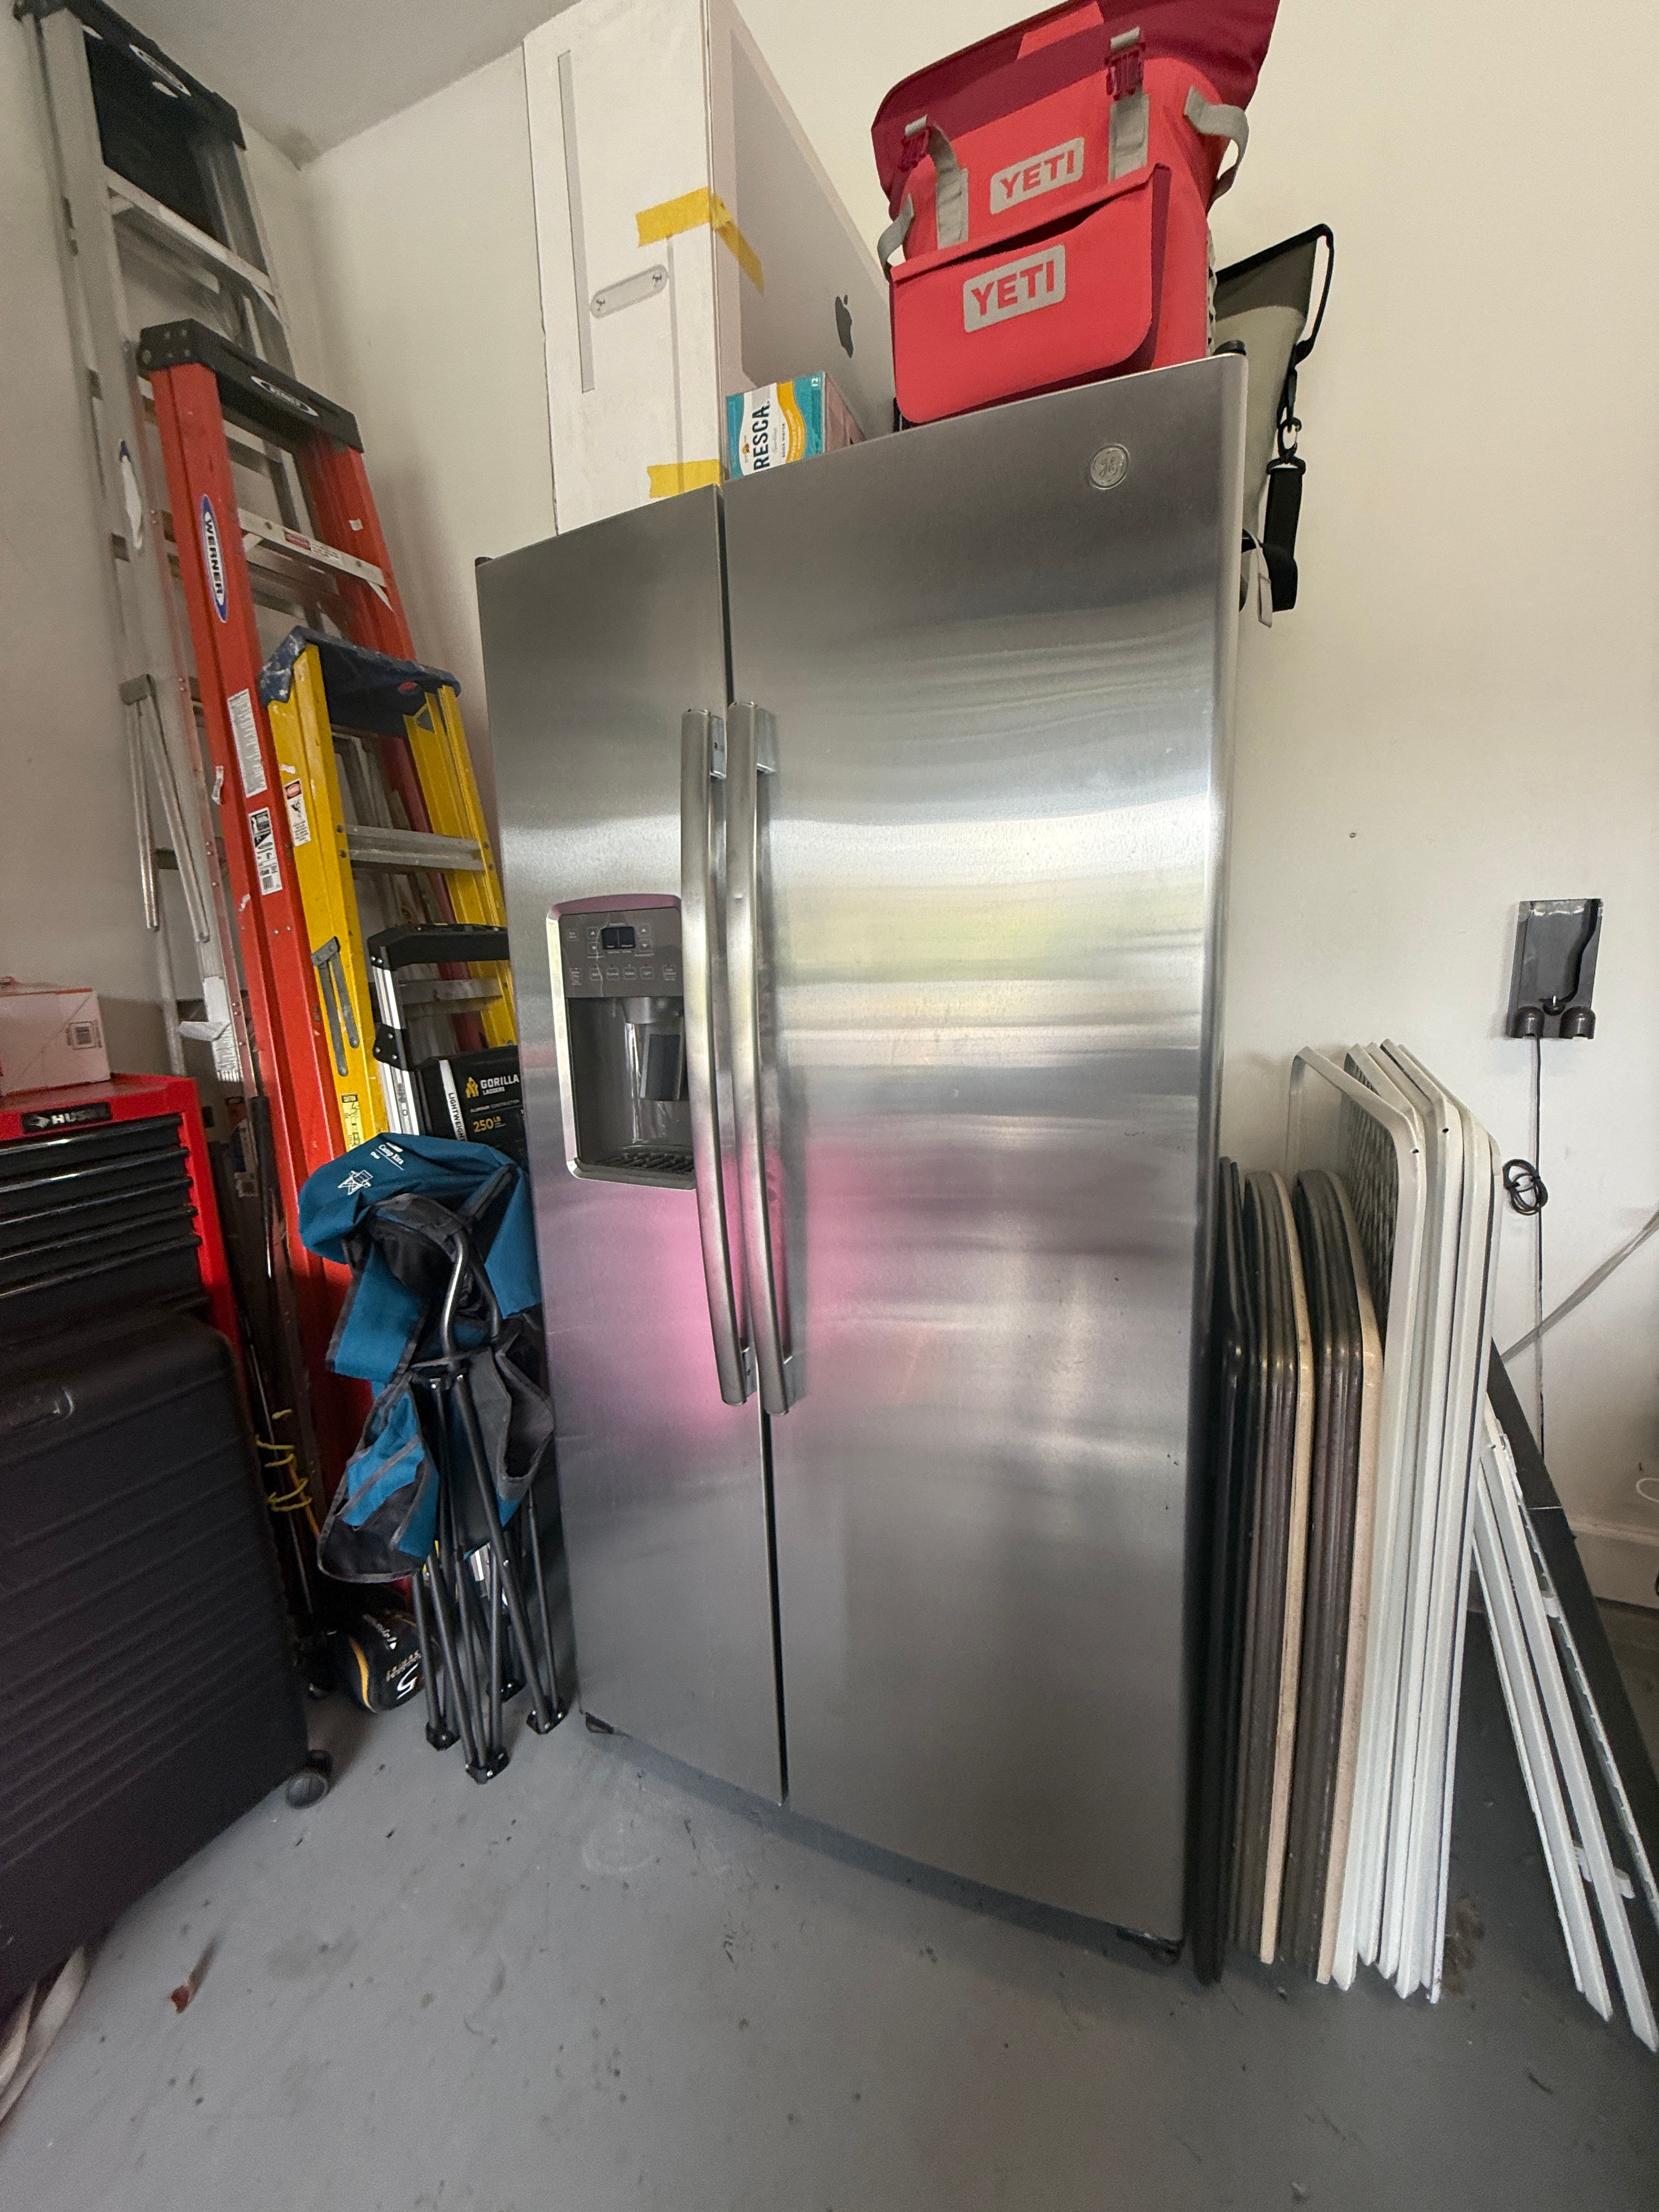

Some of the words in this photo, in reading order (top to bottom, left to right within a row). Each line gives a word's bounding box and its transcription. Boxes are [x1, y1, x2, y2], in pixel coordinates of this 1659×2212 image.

[1000, 150, 1075, 200] YETI
[971, 260, 1054, 316] YETI
[811, 376, 819, 386] 12
[205, 518, 224, 594] WERNER
[480, 1074, 520, 1089] GORILLA
[473, 1118, 494, 1133] 250
[378, 1144, 394, 1157] Camp
